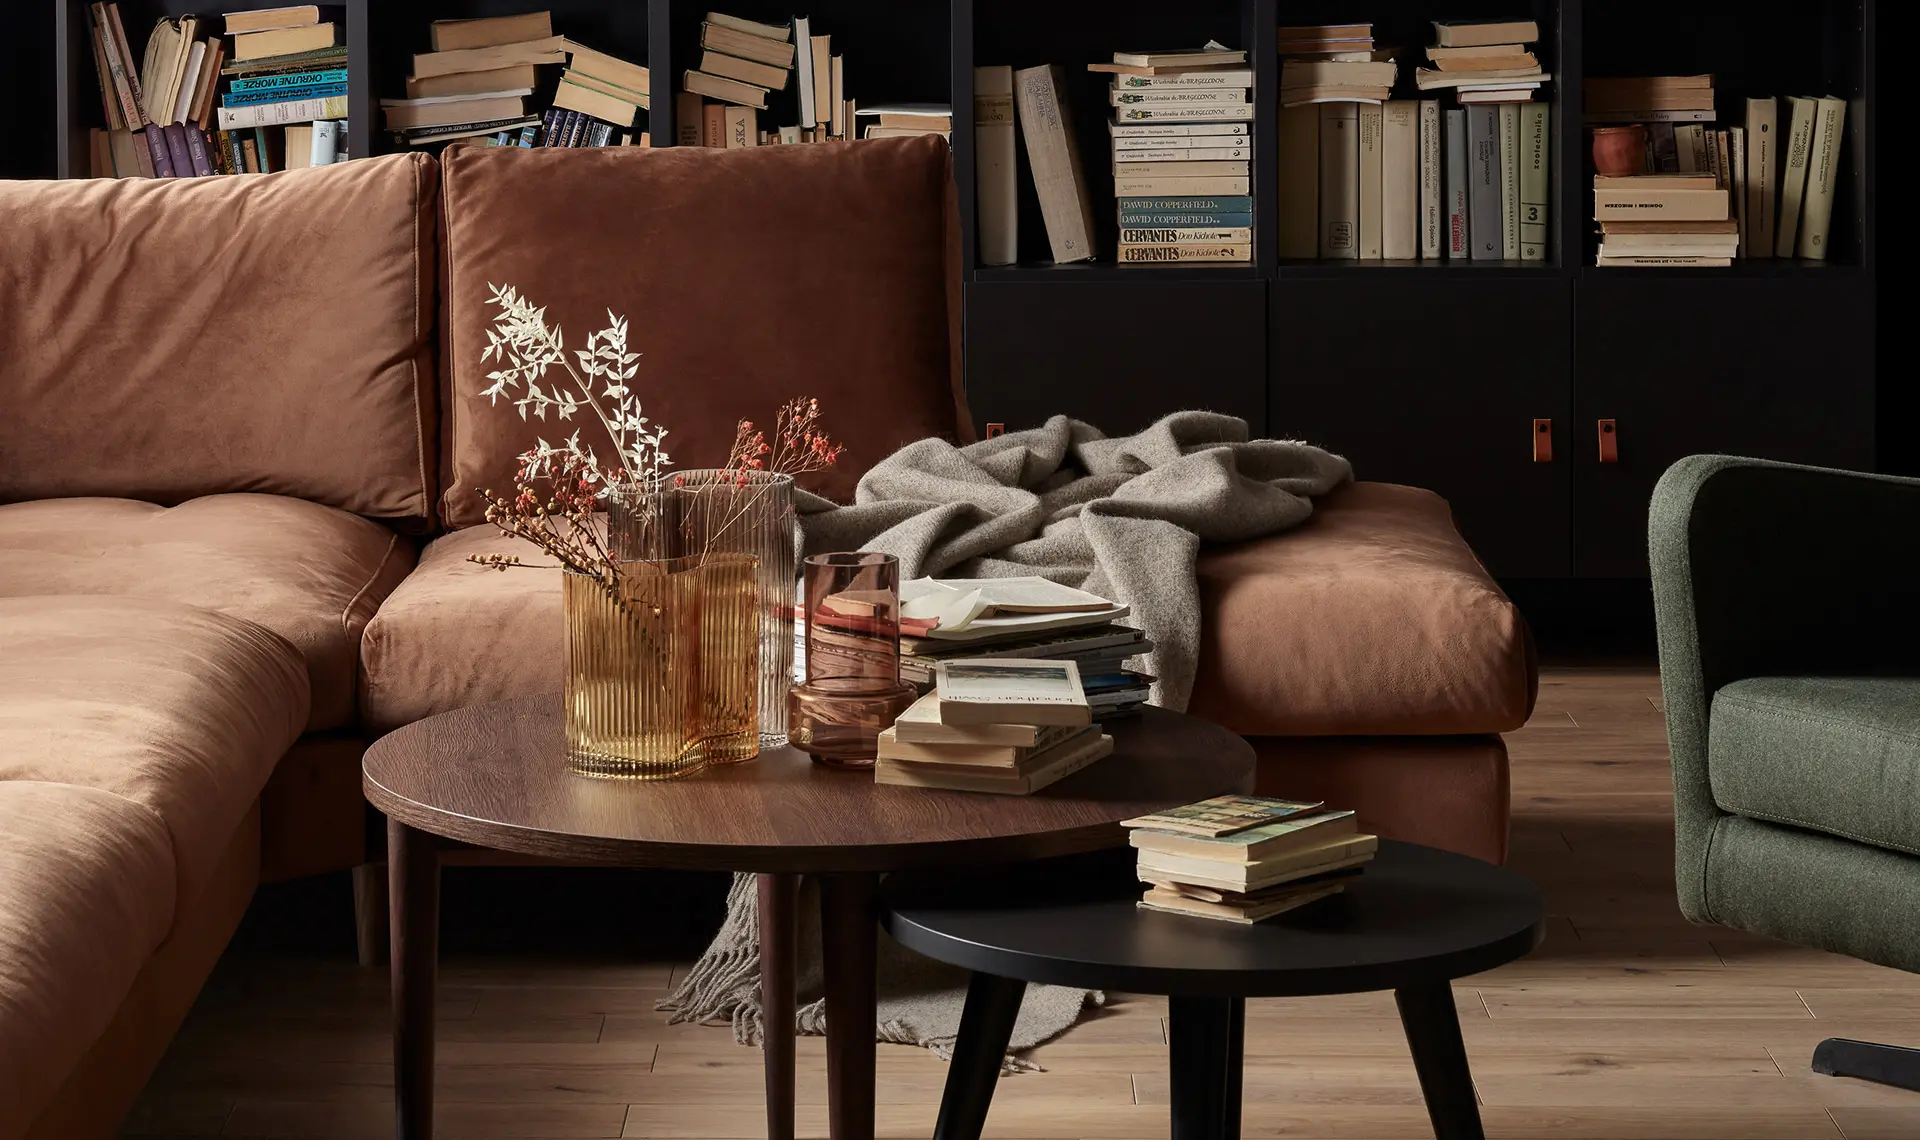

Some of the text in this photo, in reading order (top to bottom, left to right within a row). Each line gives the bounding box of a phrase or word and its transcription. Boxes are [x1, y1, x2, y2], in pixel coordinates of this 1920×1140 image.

[243, 74, 323, 90] OKRUTNE MORZE
[233, 87, 313, 104] OKRUTNE MORZE
[1532, 113, 1543, 170] zootechnika
[1123, 201, 1153, 209] DAWID
[1122, 215, 1151, 224] DAWID
[1527, 207, 1538, 221] 3
[1123, 229, 1177, 242] CERVANTES
[1178, 231, 1192, 240] Don
[1193, 231, 1218, 240] Kichote
[1125, 246, 1235, 261] CERVANTES Don Kichote 2
